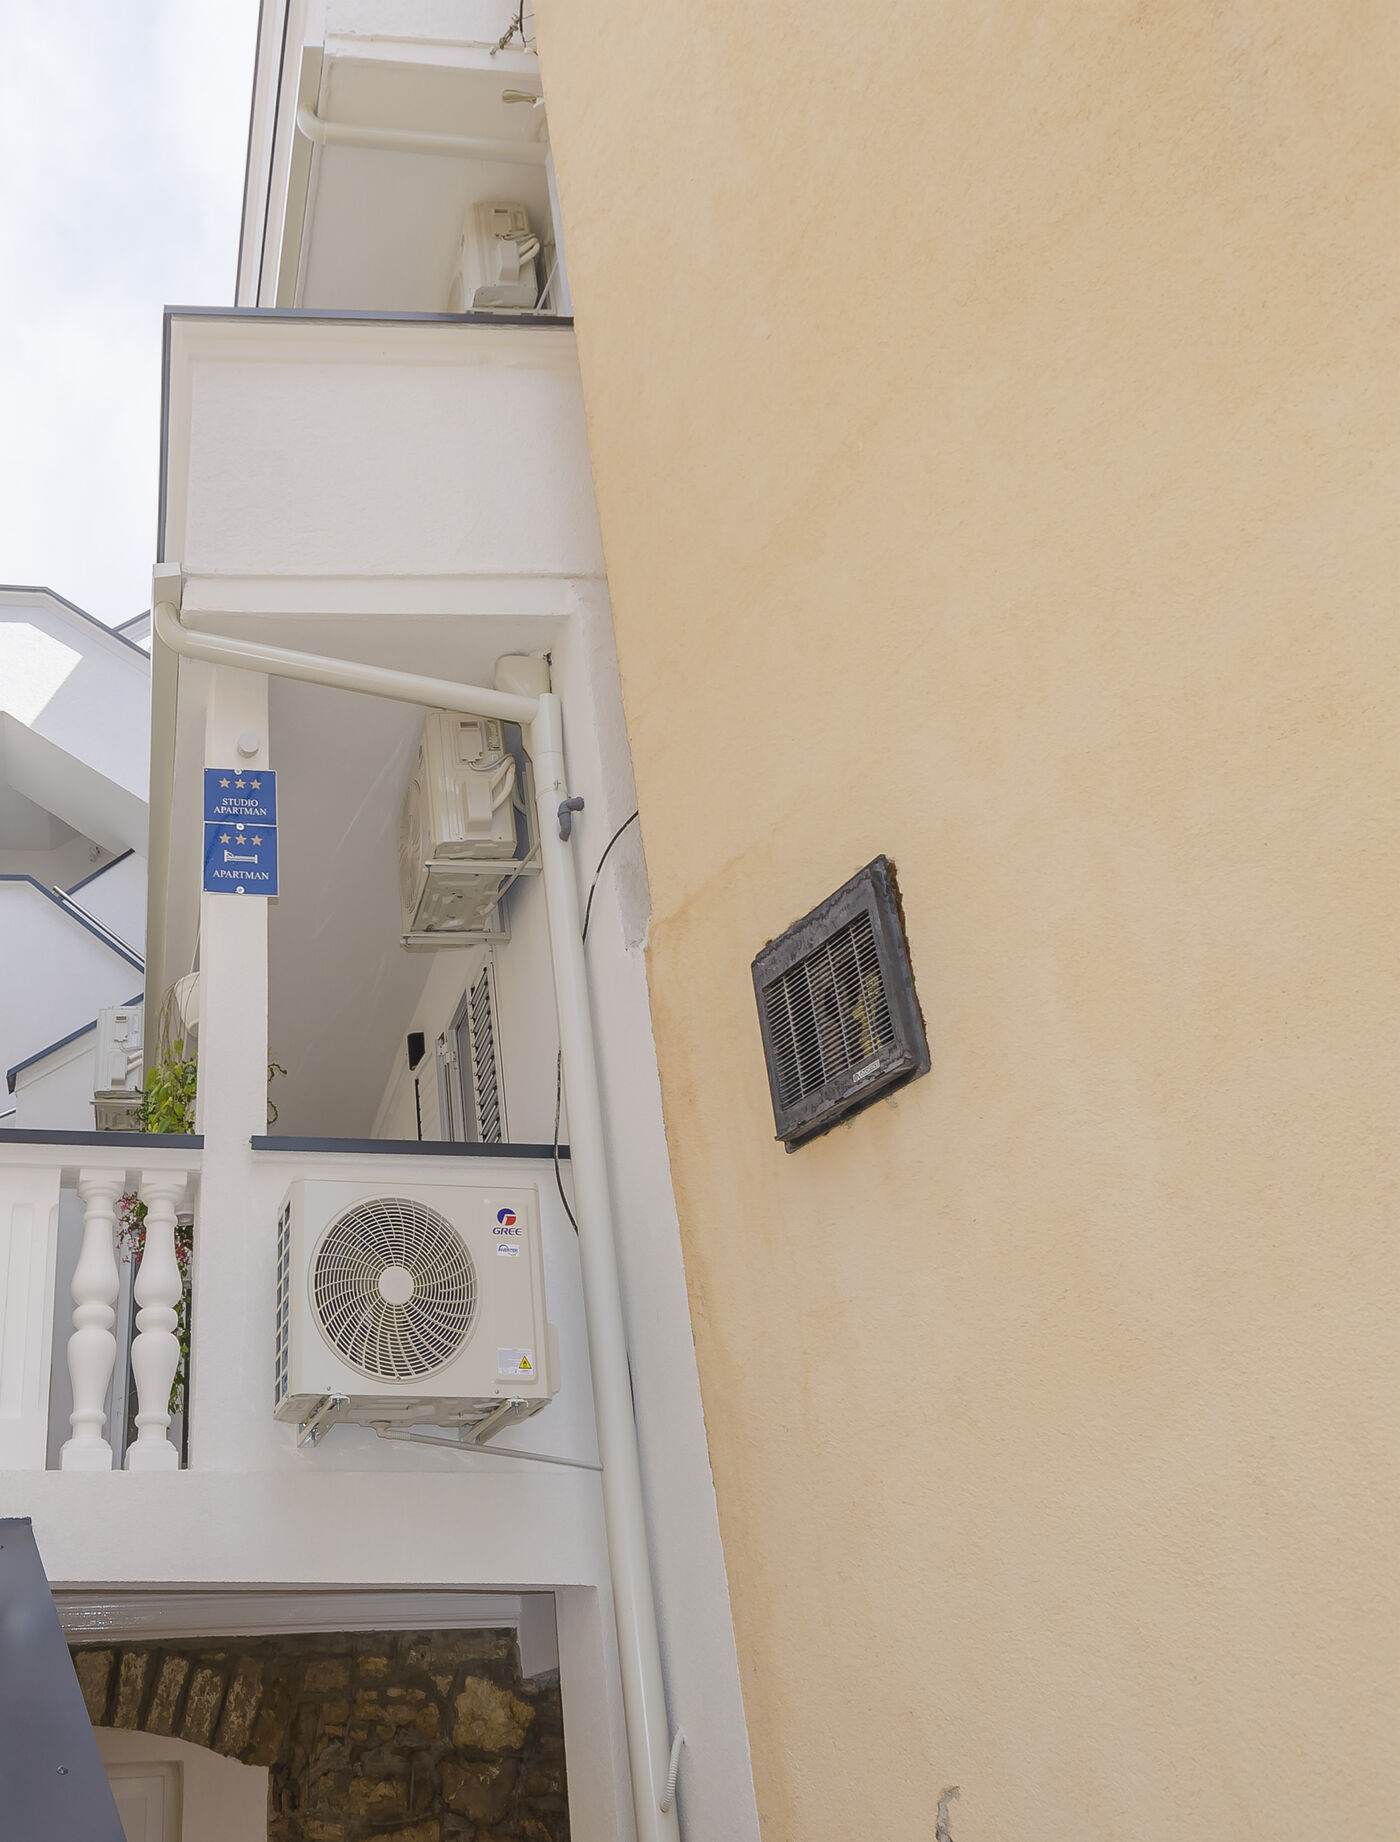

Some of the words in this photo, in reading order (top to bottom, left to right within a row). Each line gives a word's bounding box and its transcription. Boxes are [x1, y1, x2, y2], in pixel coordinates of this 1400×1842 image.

[222, 797, 259, 807] STUDIO
[213, 806, 267, 816] APARTMAN
[212, 870, 269, 880] APARTMAN
[492, 1227, 522, 1236] GREE
